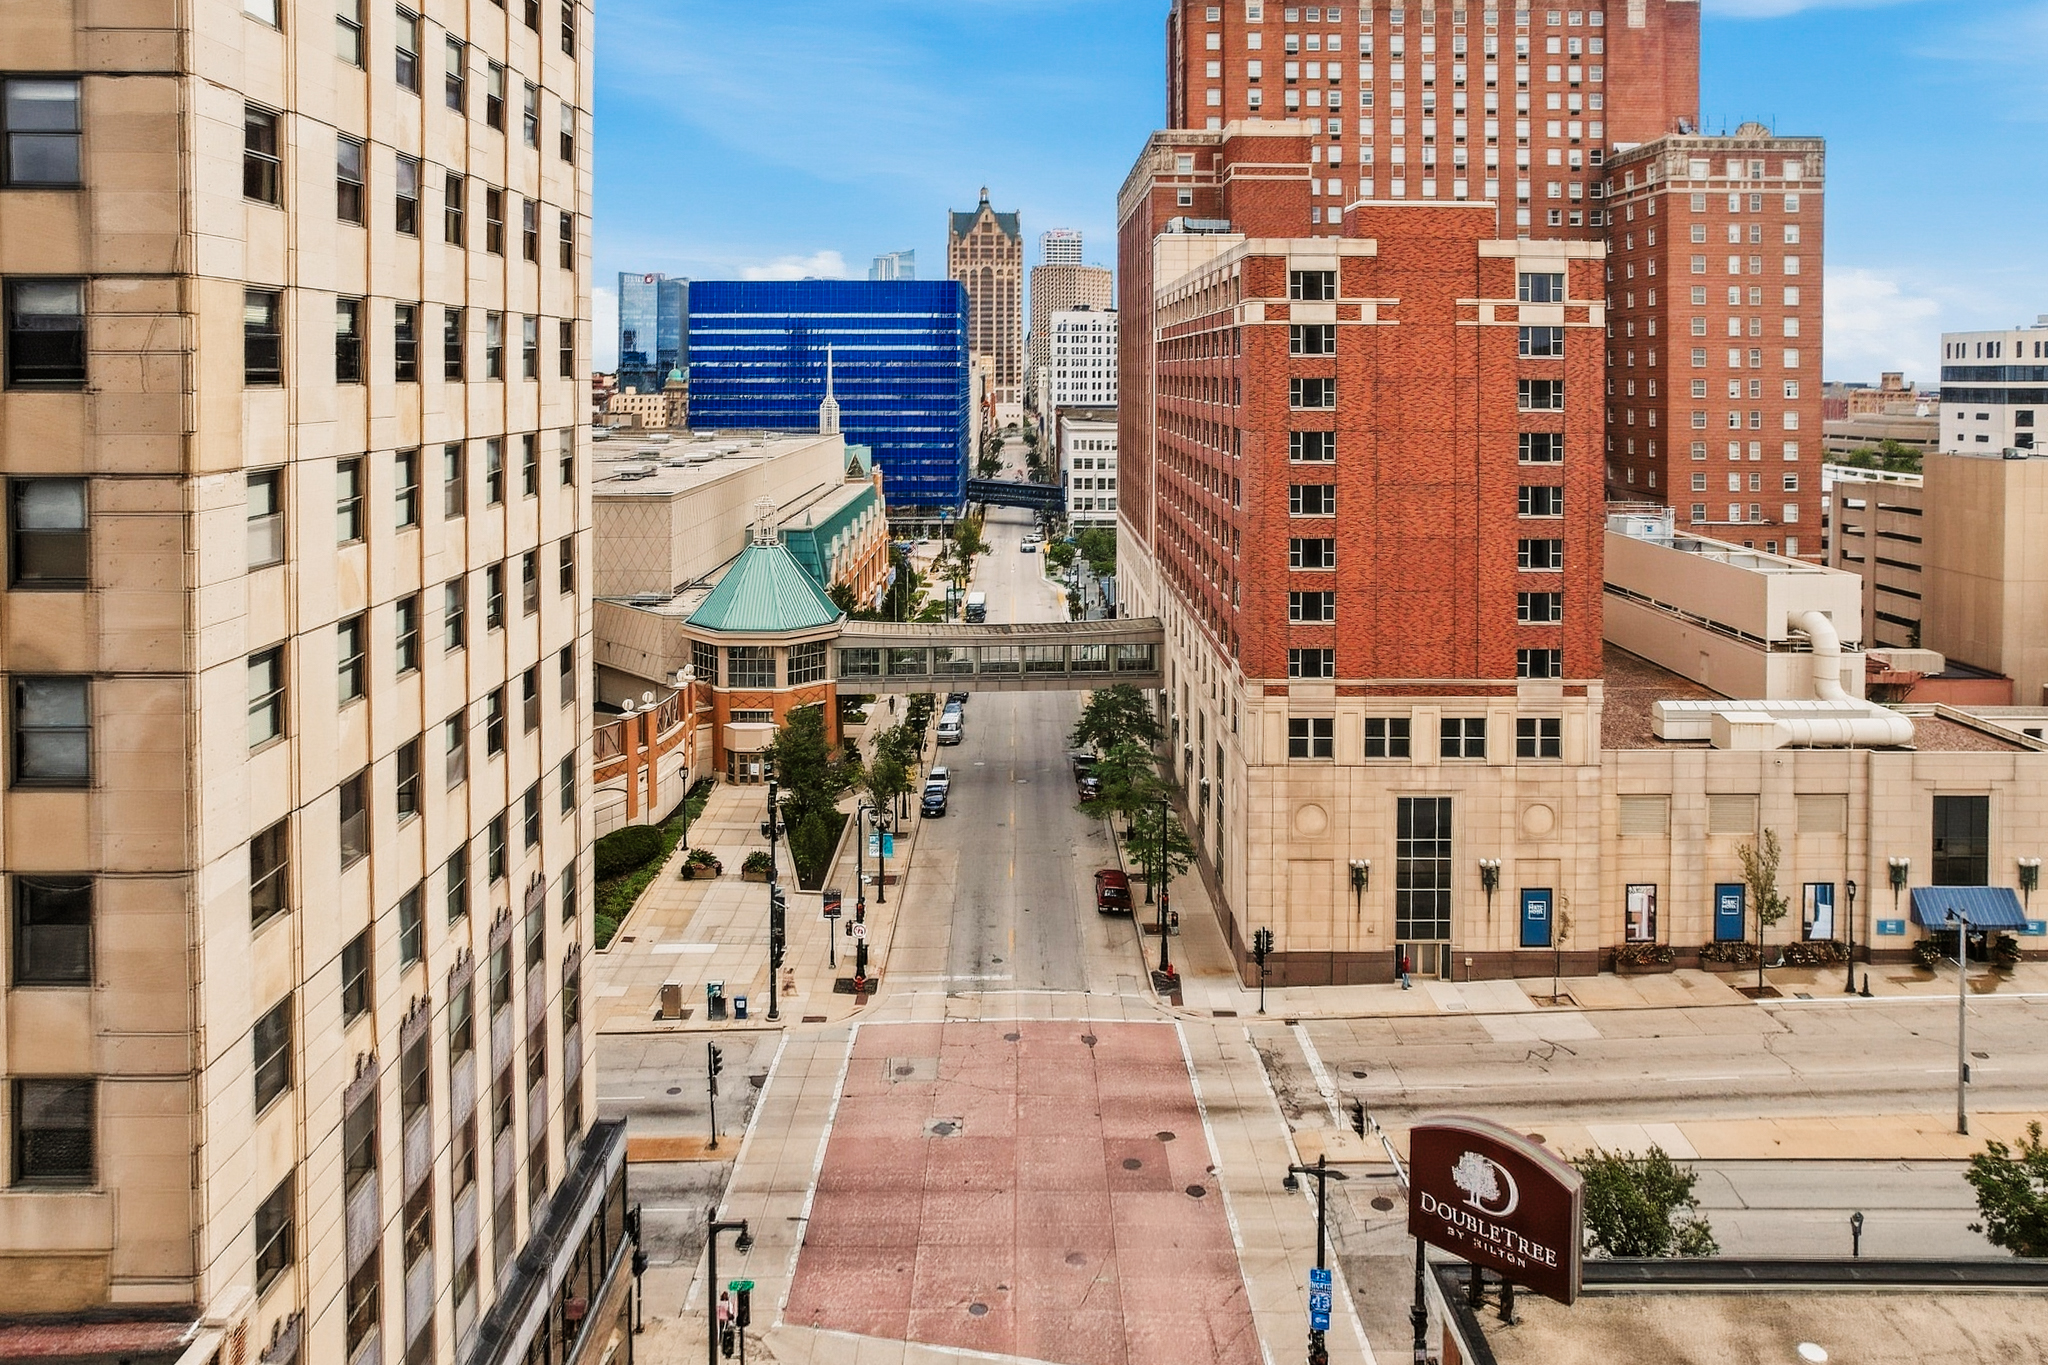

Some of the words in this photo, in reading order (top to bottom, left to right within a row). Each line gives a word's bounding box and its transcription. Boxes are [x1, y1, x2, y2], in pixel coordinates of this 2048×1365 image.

[1420, 1190, 1558, 1271] DOUBLETREE
[1447, 1225, 1465, 1240] BY
[1473, 1237, 1527, 1269] HILTON
